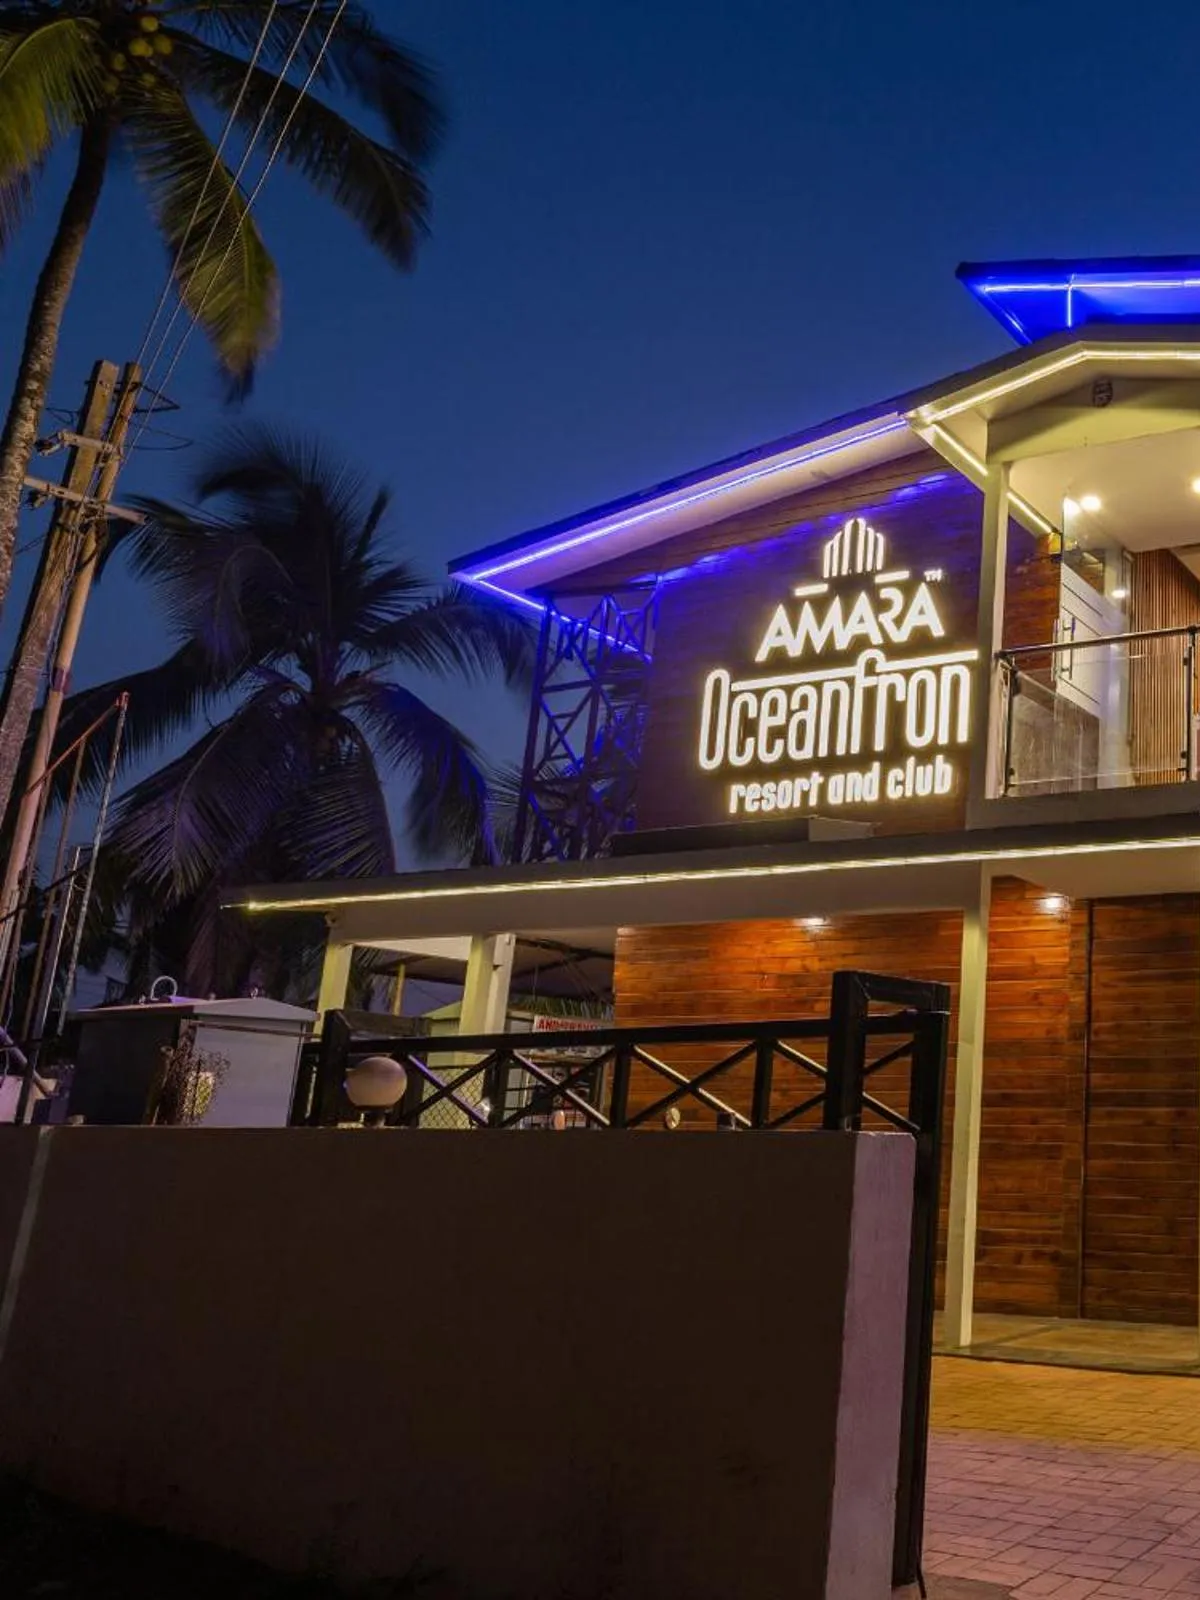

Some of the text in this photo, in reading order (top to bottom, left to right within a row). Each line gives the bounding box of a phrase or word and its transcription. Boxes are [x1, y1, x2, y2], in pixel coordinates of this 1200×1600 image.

[755, 583, 945, 663] AMARA
[699, 649, 978, 770] Oceanfron
[729, 755, 953, 815] resort and club
